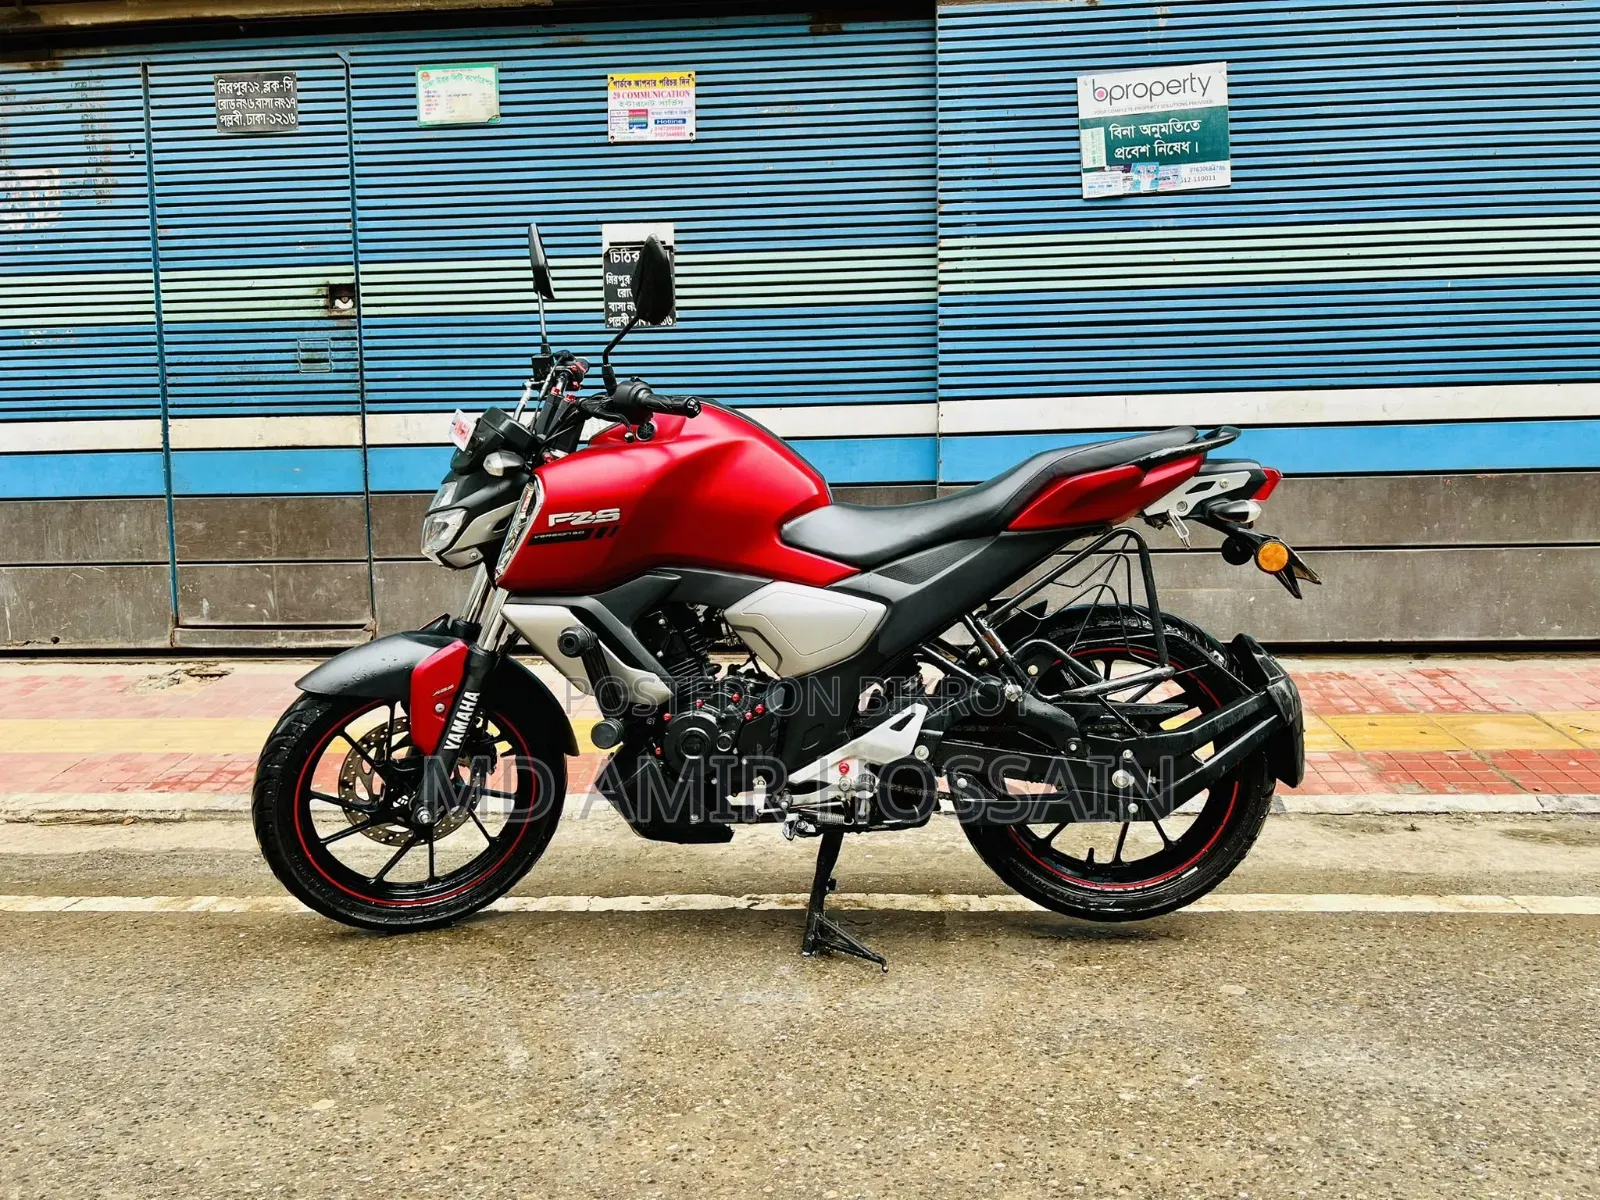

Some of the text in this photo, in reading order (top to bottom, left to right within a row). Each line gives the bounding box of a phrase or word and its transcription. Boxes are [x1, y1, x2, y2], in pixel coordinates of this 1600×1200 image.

[622, 90, 690, 99] COMMUNICATION
[1092, 72, 1212, 106] bproperty
[218, 99, 236, 110] রোড
[1109, 118, 1202, 140] বিনা অনুমতিতে
[1114, 143, 1151, 160] প্রবেশ
[443, 691, 481, 750] YAMAHA
